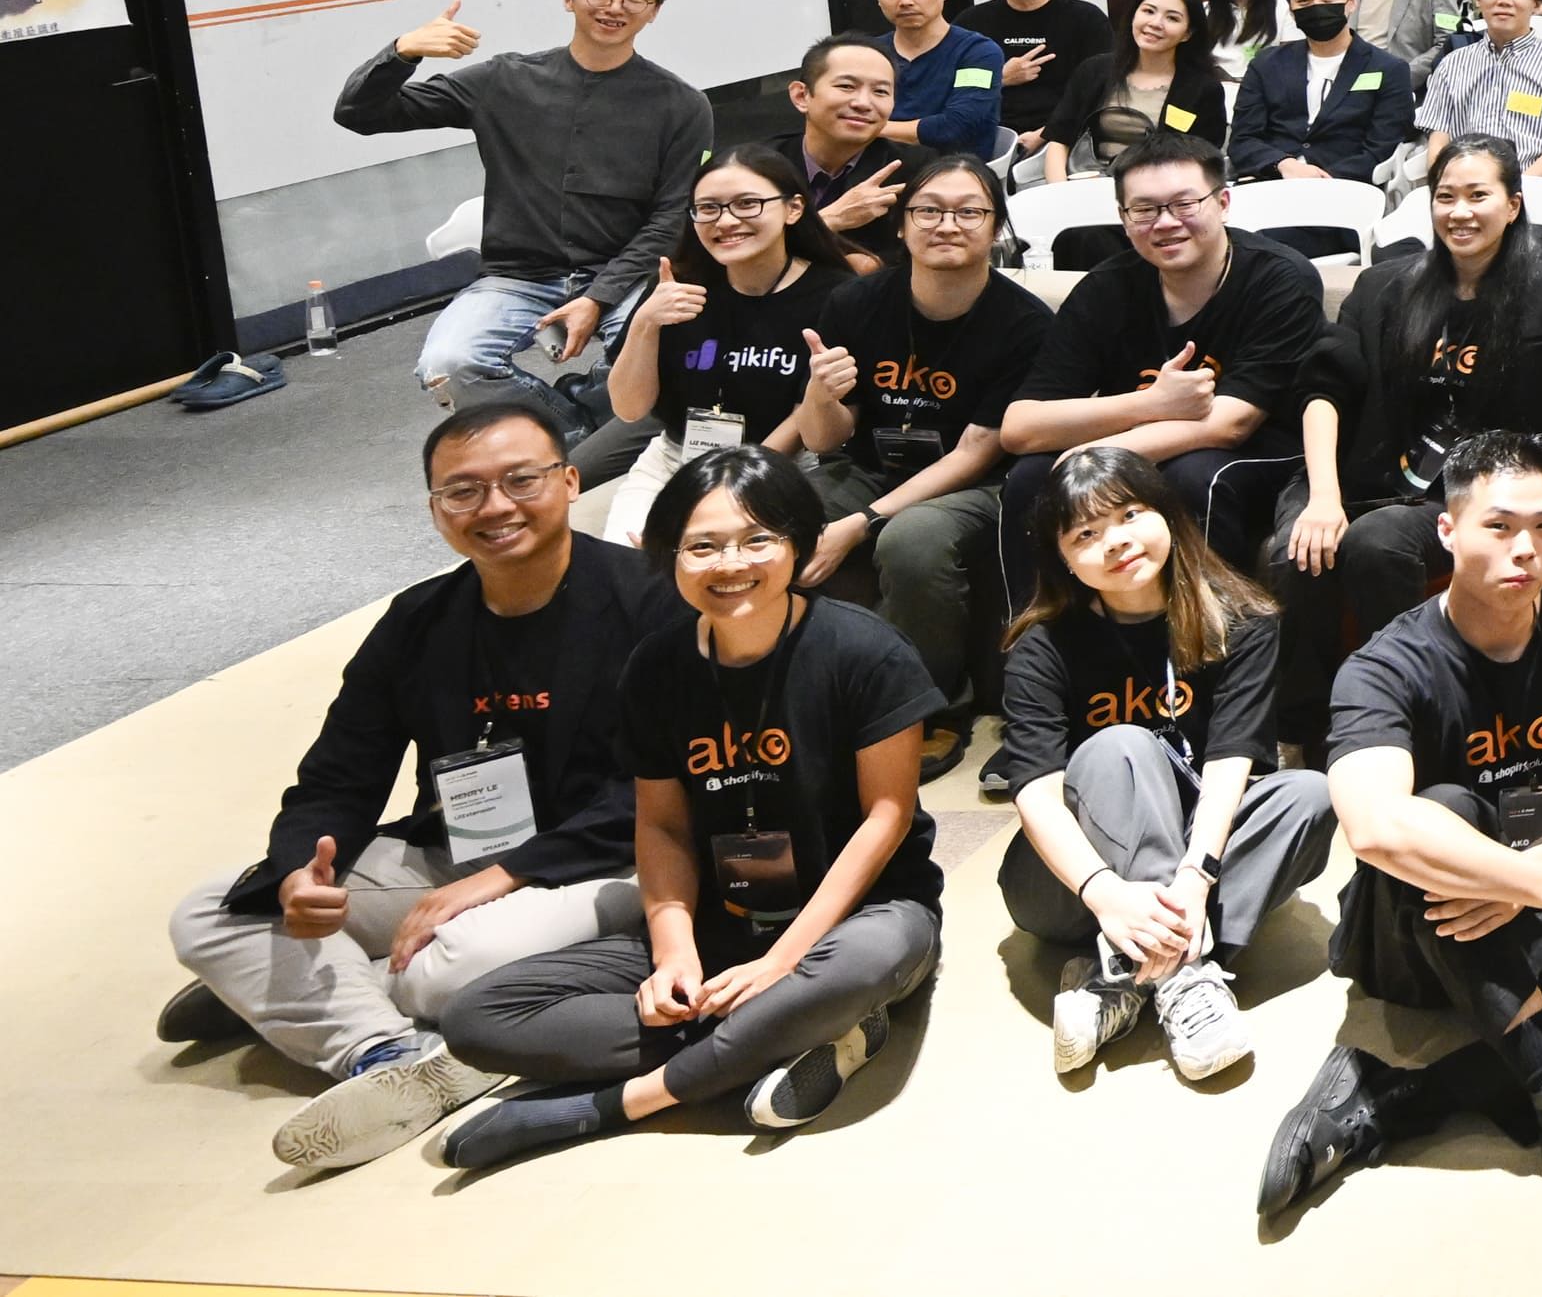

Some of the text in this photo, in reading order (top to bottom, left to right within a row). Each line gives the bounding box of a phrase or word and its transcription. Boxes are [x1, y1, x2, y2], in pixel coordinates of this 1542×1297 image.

[873, 354, 958, 400] ako
[1086, 676, 1193, 727] ako
[687, 721, 791, 775] ako
[1511, 839, 1530, 848] AKO
